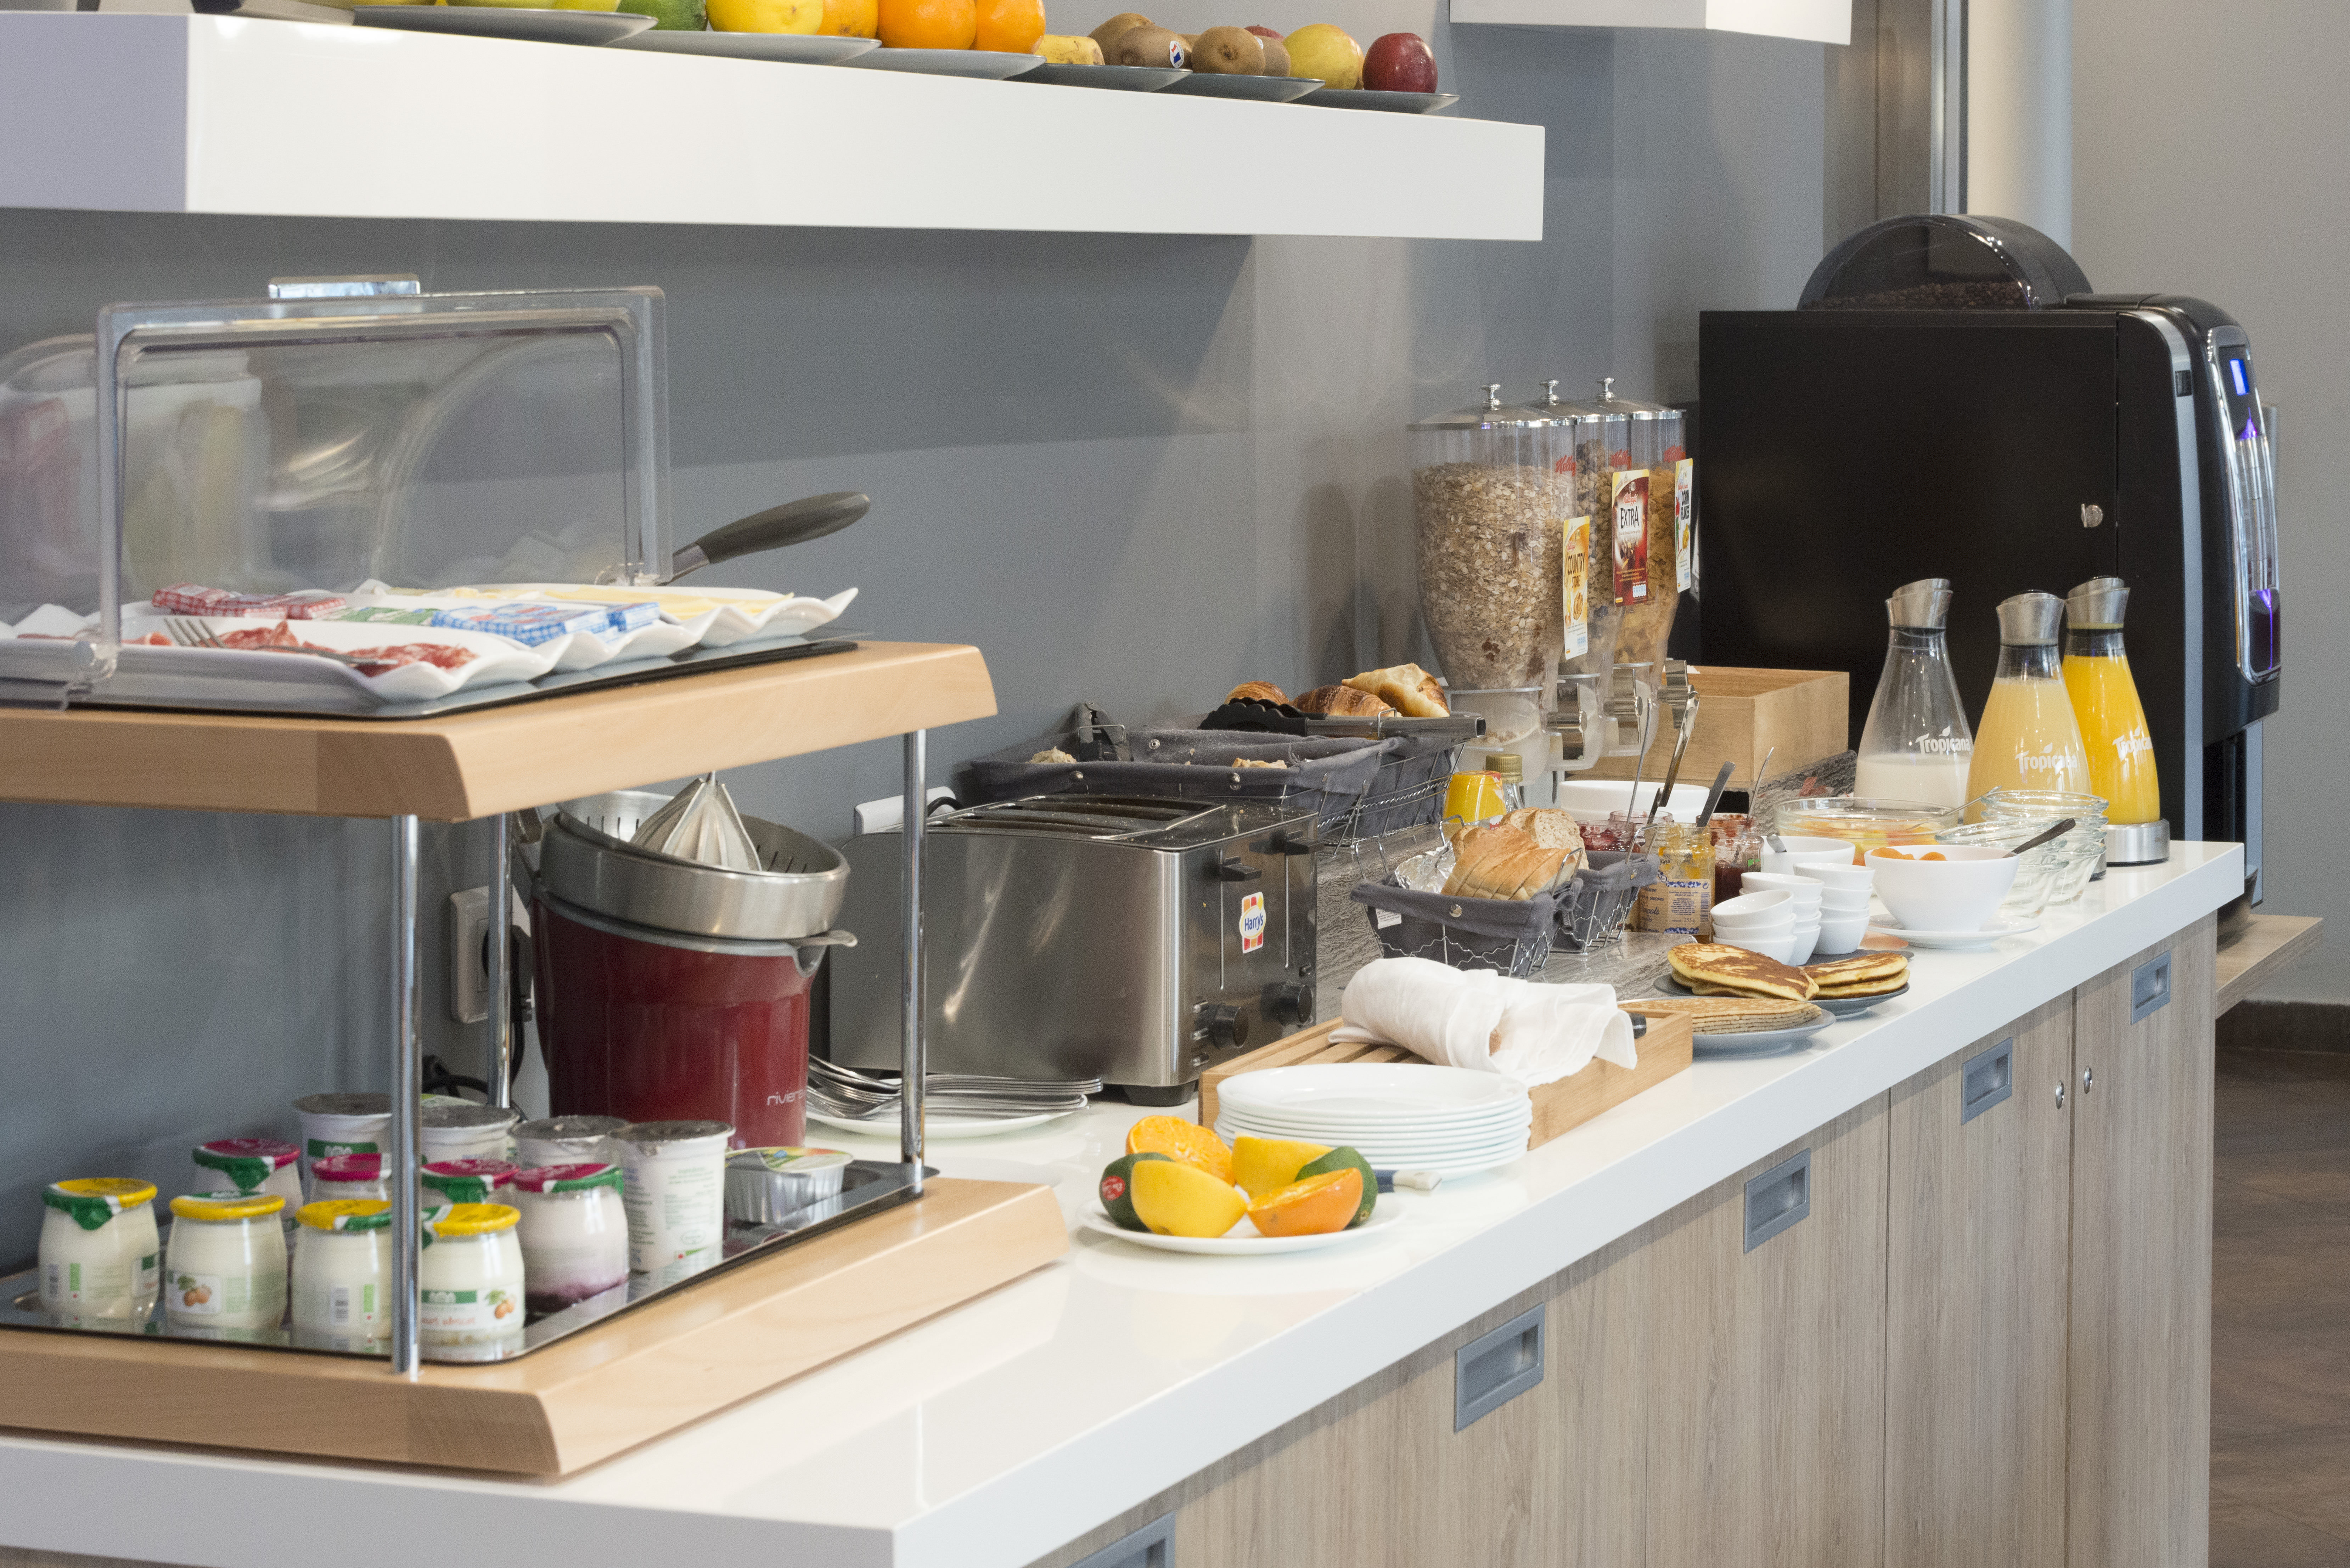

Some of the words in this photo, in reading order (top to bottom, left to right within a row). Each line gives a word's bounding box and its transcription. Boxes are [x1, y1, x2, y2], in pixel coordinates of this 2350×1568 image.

[1620, 506, 1639, 529] EXTRA
[1568, 552, 1585, 575] COUNTRY
[1915, 733, 1971, 755] Tropicana
[2015, 750, 2078, 774] Tropicana
